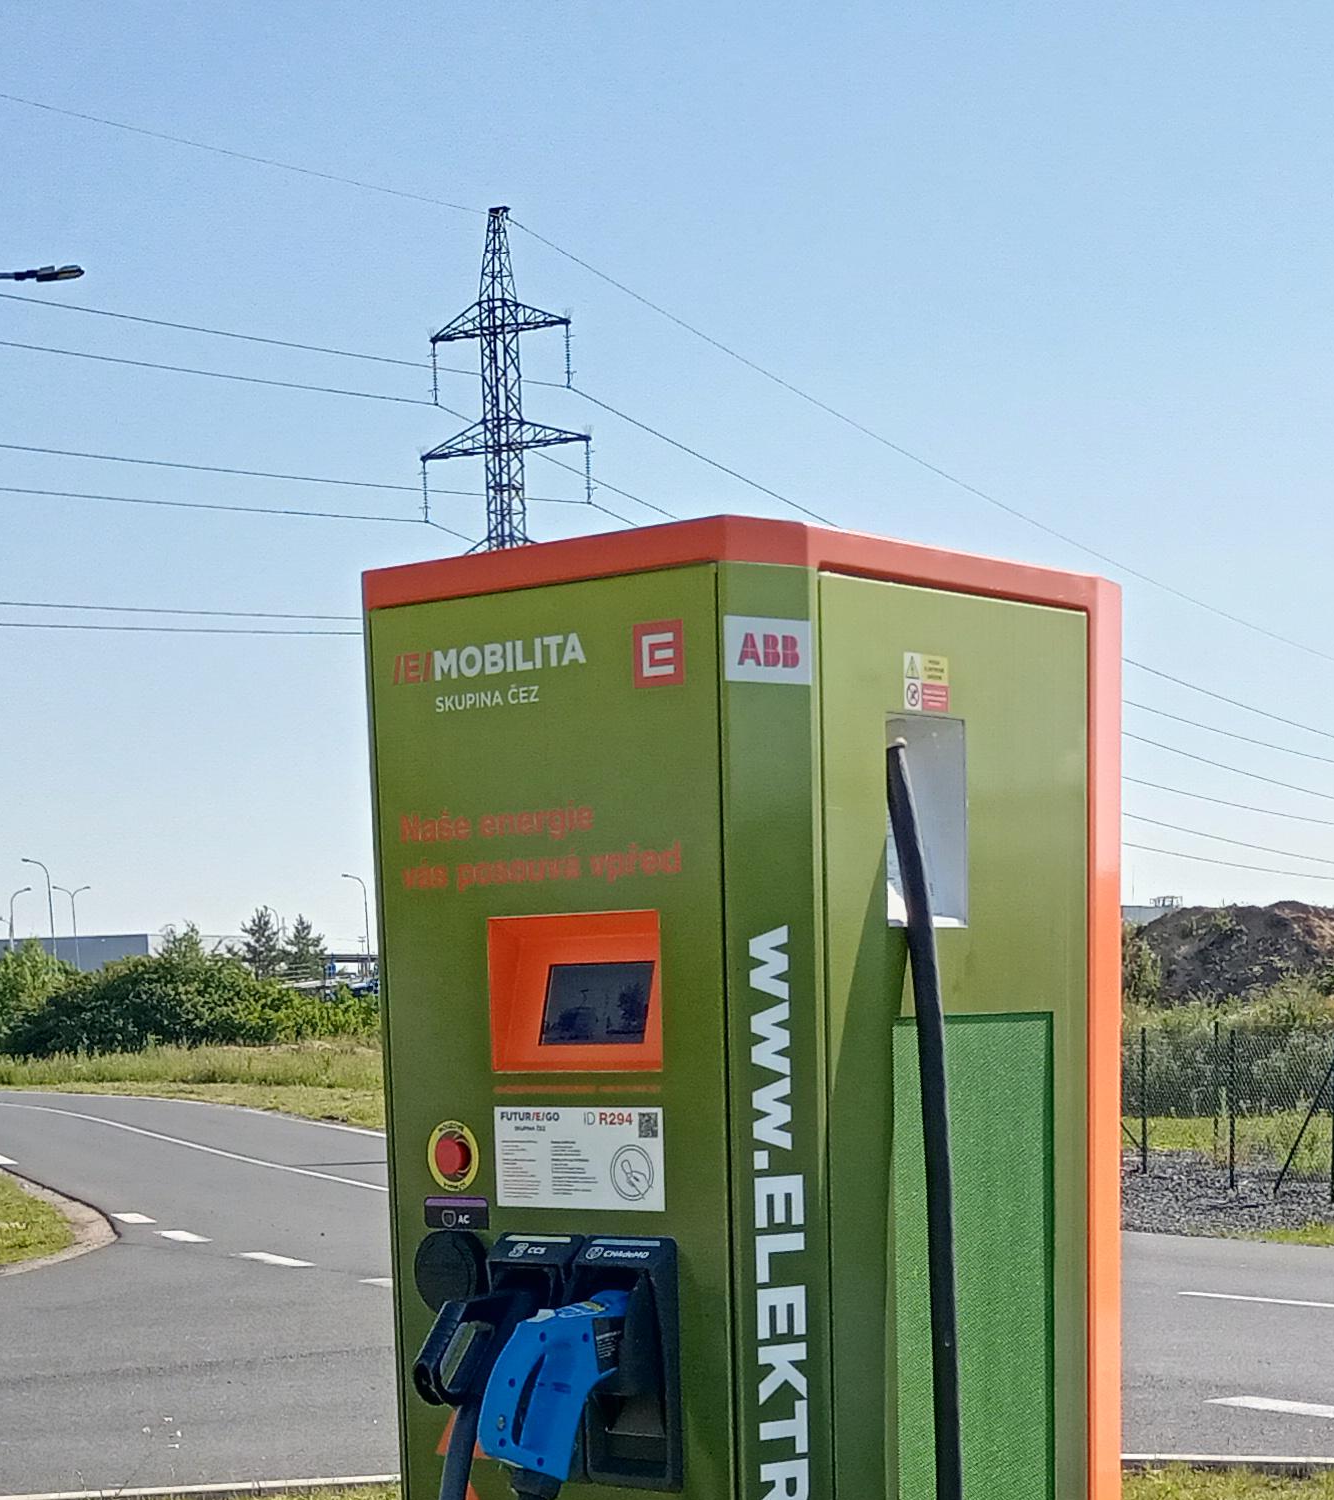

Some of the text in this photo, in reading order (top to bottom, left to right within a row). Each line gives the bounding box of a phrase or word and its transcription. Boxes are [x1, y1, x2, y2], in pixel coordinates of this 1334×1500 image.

[736, 632, 801, 669] ABB
[435, 684, 540, 713] SKUPINA ČEZ
[400, 799, 595, 843] Naše energie
[402, 840, 683, 892] vás posouvá vpřed
[583, 1111, 633, 1126] ID R294
[457, 1214, 470, 1224] AC
[527, 1246, 547, 1255] CCS
